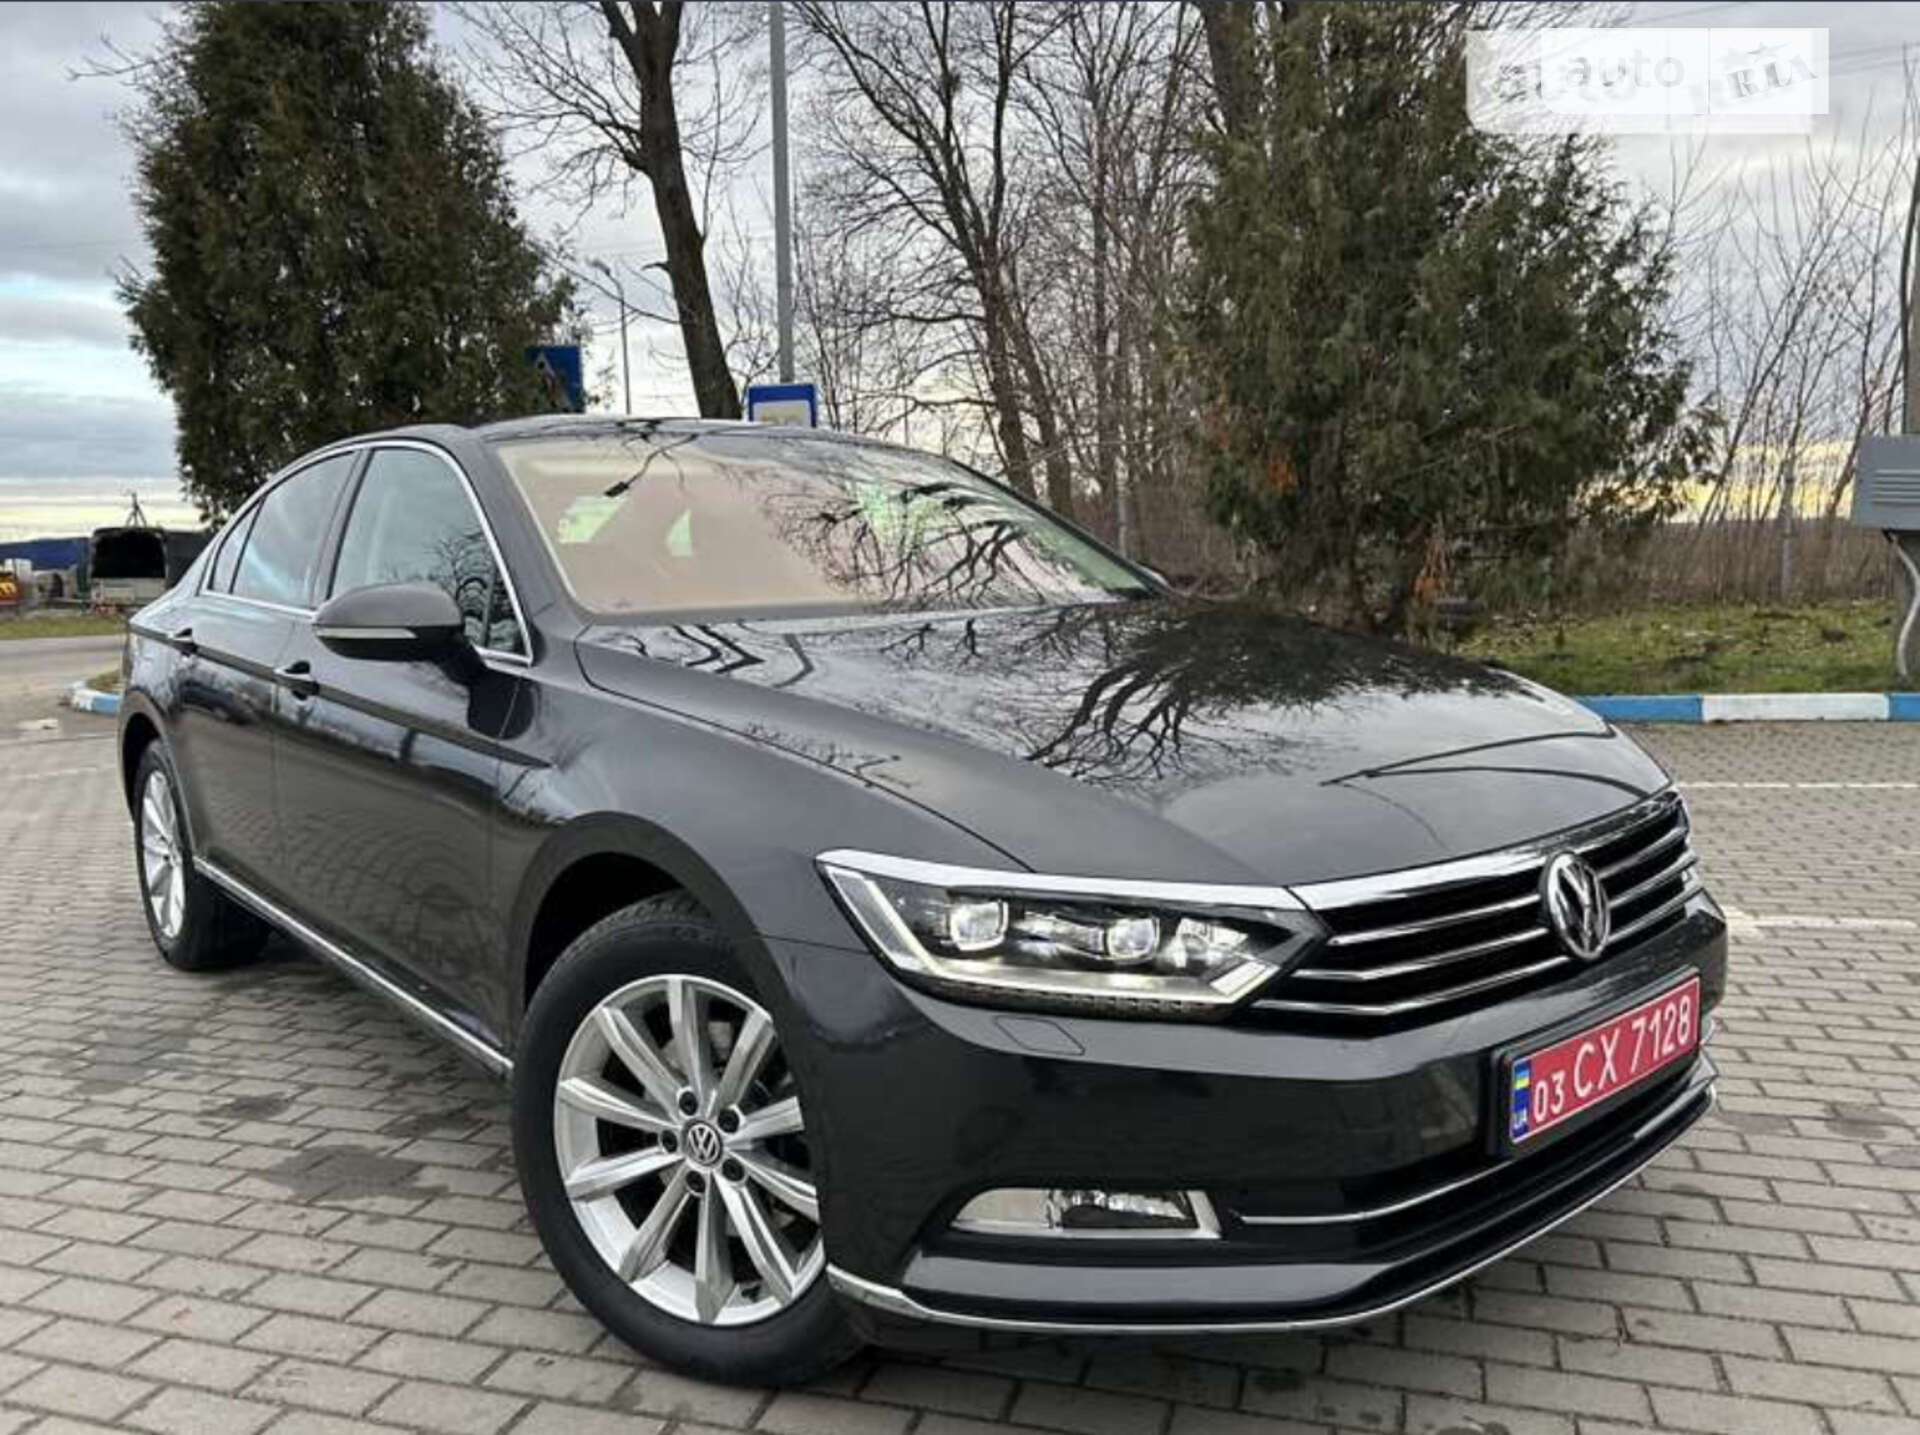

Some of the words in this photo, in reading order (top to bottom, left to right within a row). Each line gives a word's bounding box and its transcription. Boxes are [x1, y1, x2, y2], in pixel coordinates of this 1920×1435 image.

[1532, 1070, 1565, 1123] 03
[1573, 1027, 1621, 1098] CX
[1630, 995, 1691, 1074] 7128
